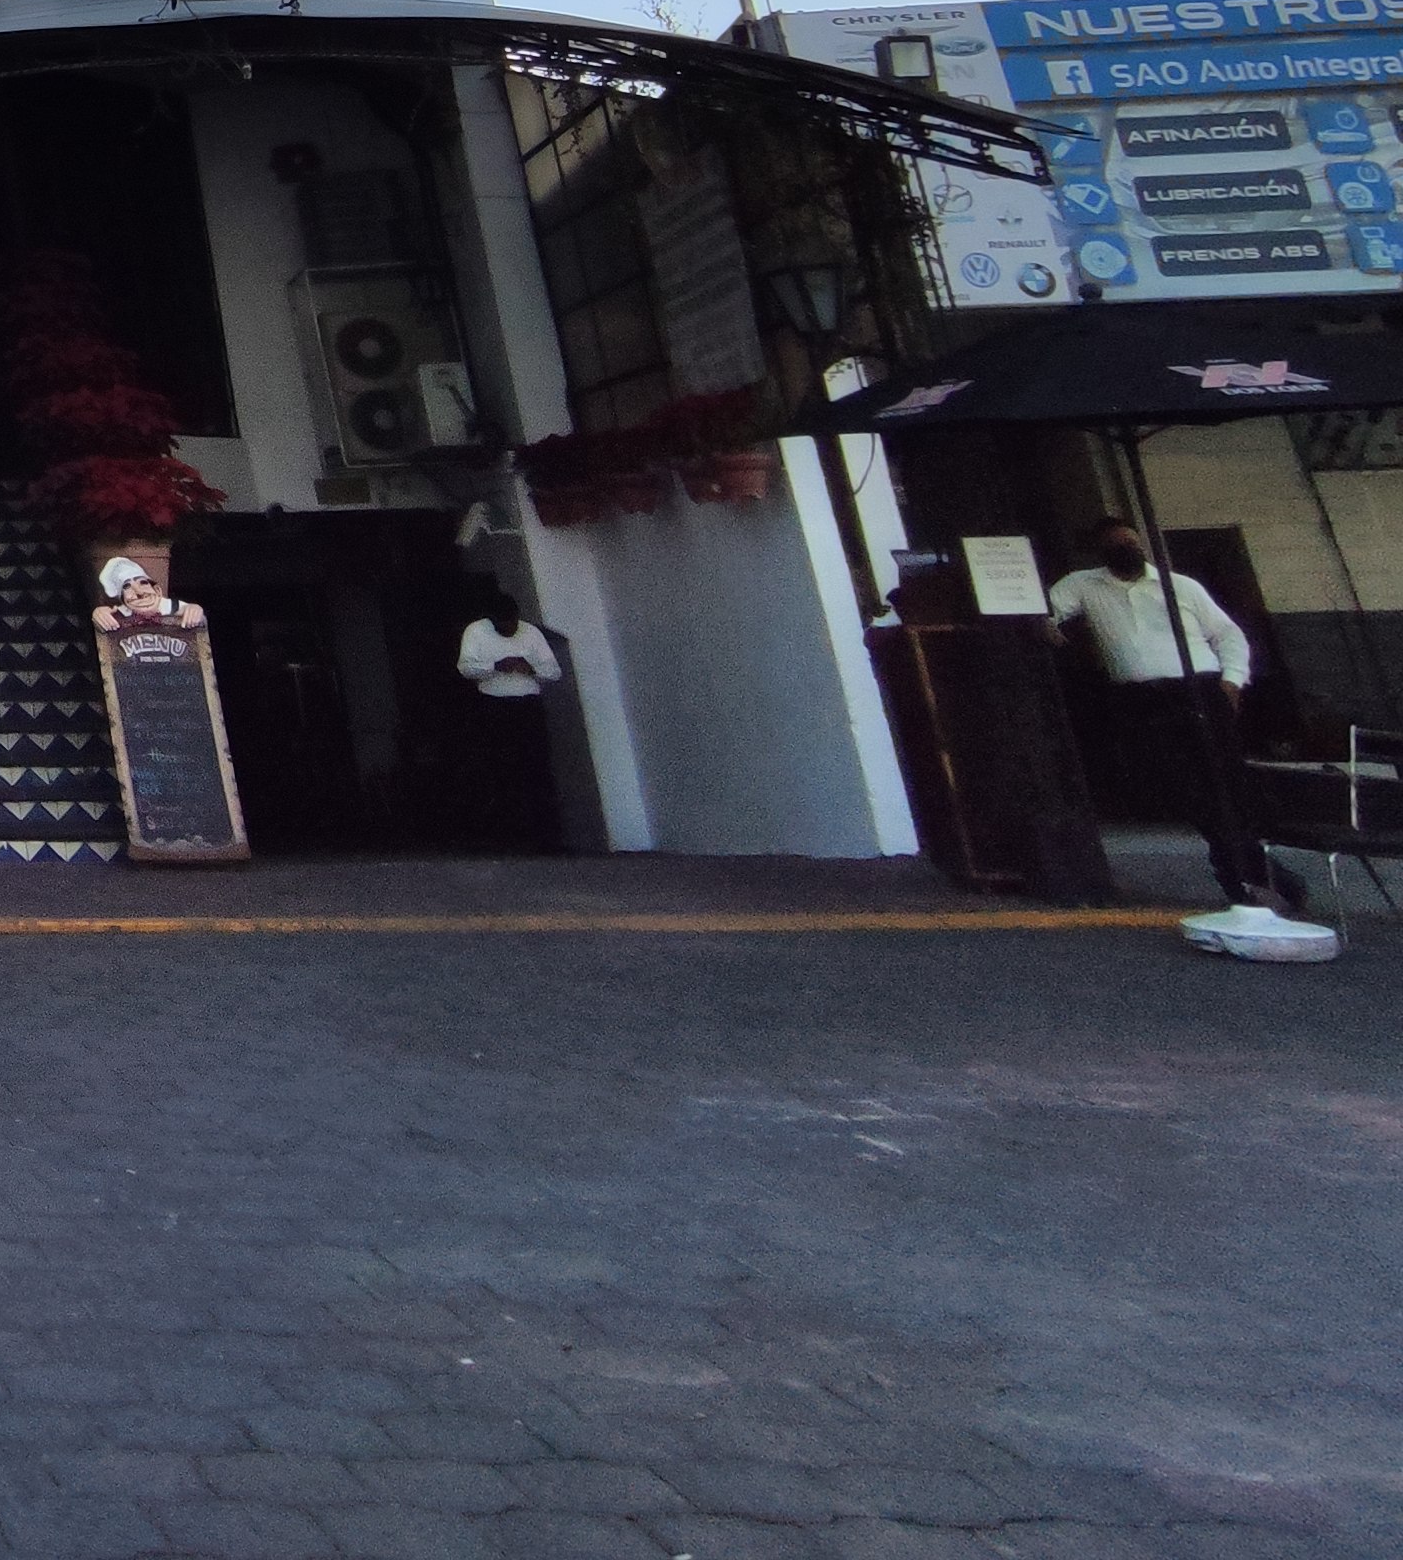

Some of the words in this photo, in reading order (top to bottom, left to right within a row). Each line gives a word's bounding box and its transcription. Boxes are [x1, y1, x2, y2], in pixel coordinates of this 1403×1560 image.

[831, 10, 966, 26] CHRYSLER
[1109, 61, 1189, 88] SAO
[1200, 58, 1279, 83] Auto
[1285, 51, 1403, 81] Integra
[1127, 118, 1279, 144] AFINACIÓN
[1142, 180, 1300, 202] LUBRICACIÓN
[988, 239, 1046, 250] RENAULT
[1270, 245, 1321, 259] ABS
[119, 633, 188, 658] MENU
